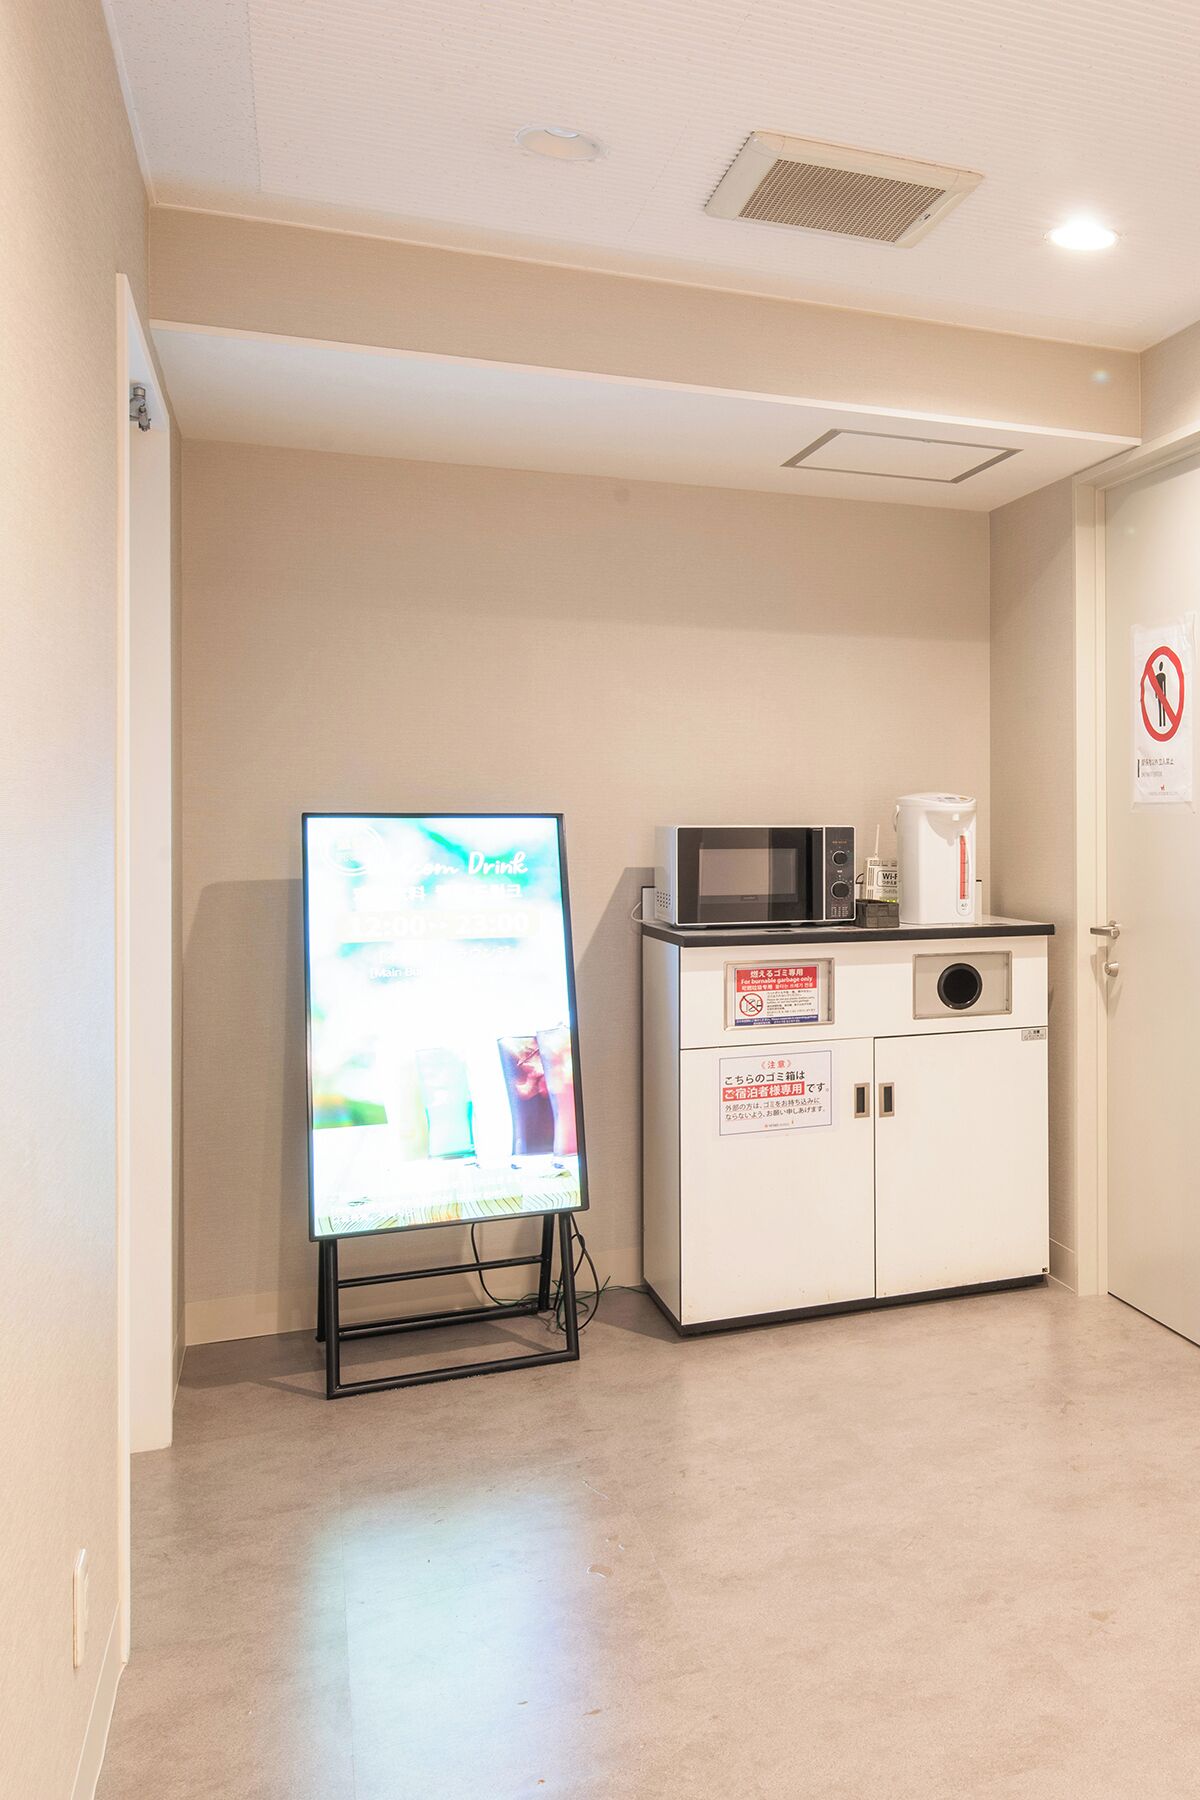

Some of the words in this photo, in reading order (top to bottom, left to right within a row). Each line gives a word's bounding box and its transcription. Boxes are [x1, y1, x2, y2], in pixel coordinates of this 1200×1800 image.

[468, 851, 528, 874] Drink
[750, 968, 804, 978] 燃えるゴミ専用
[777, 976, 800, 985] garbage
[724, 1070, 805, 1086] こちらのゴミ箱は
[724, 1084, 802, 1100] ご宿泊者様専用
[725, 1097, 820, 1112] 外部の方は、ゴミをお持ち込みに
